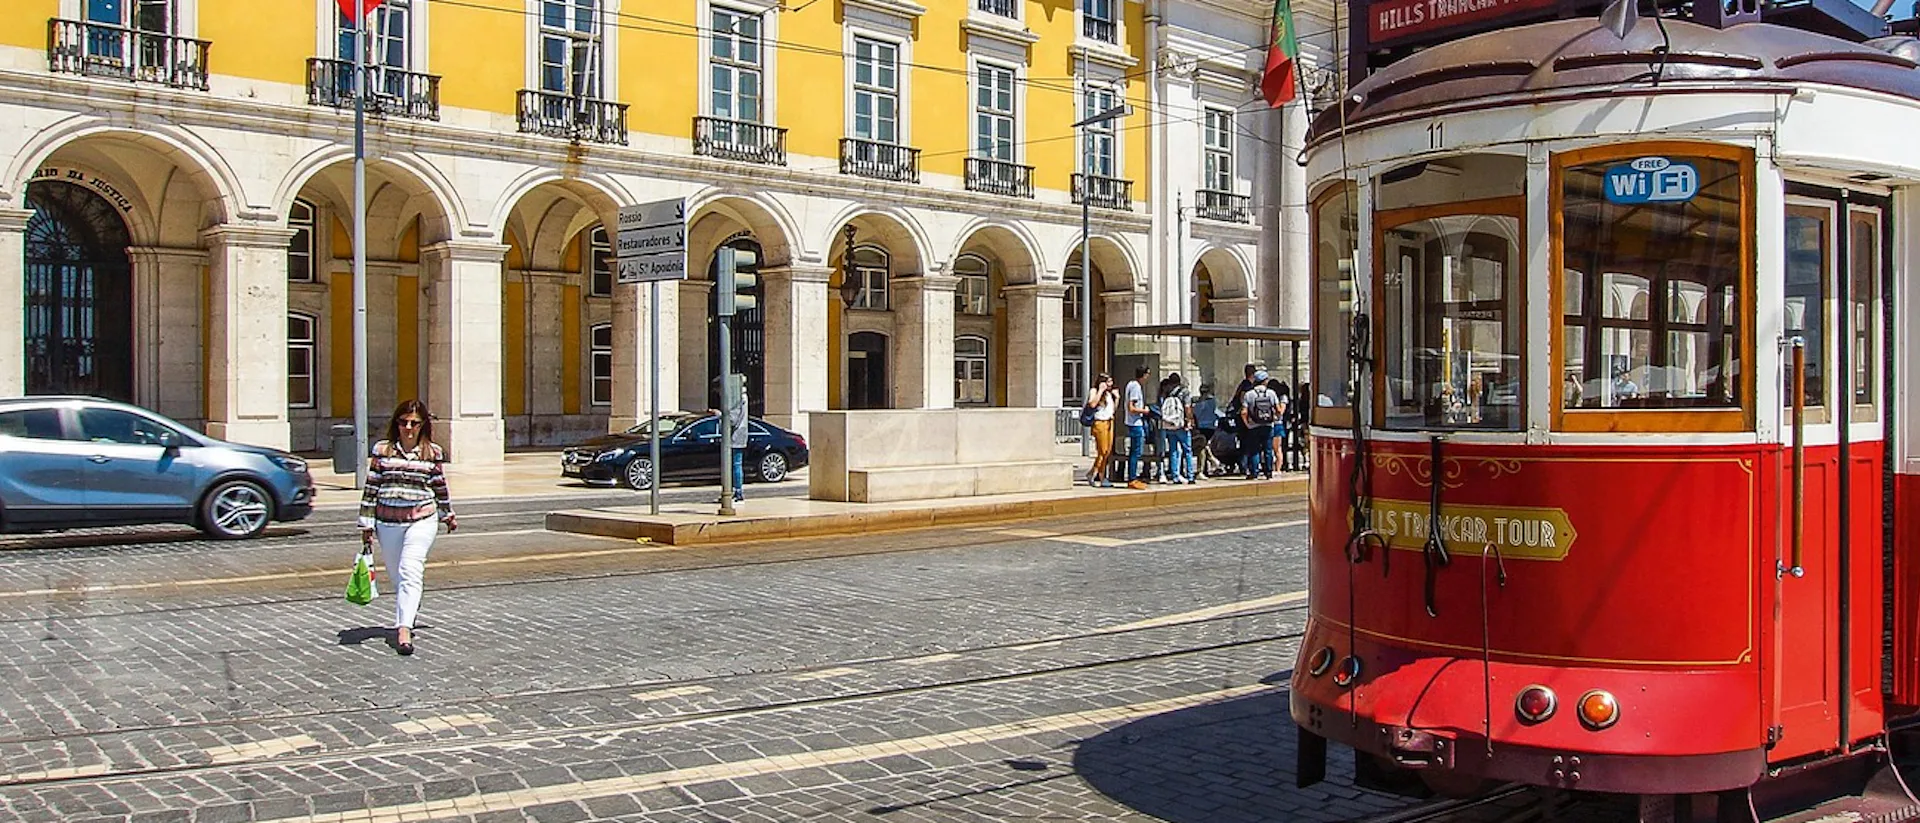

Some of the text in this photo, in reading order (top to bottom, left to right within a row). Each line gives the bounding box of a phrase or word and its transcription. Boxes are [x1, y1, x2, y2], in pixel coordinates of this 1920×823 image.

[1379, 3, 1424, 31] HILLS
[1426, 122, 1443, 149] 11
[1638, 159, 1663, 169] FREE
[619, 211, 642, 224] Rossio
[618, 234, 671, 250] Restauradores
[1354, 507, 1398, 537] ILLS
[1494, 517, 1556, 548] TOUR
